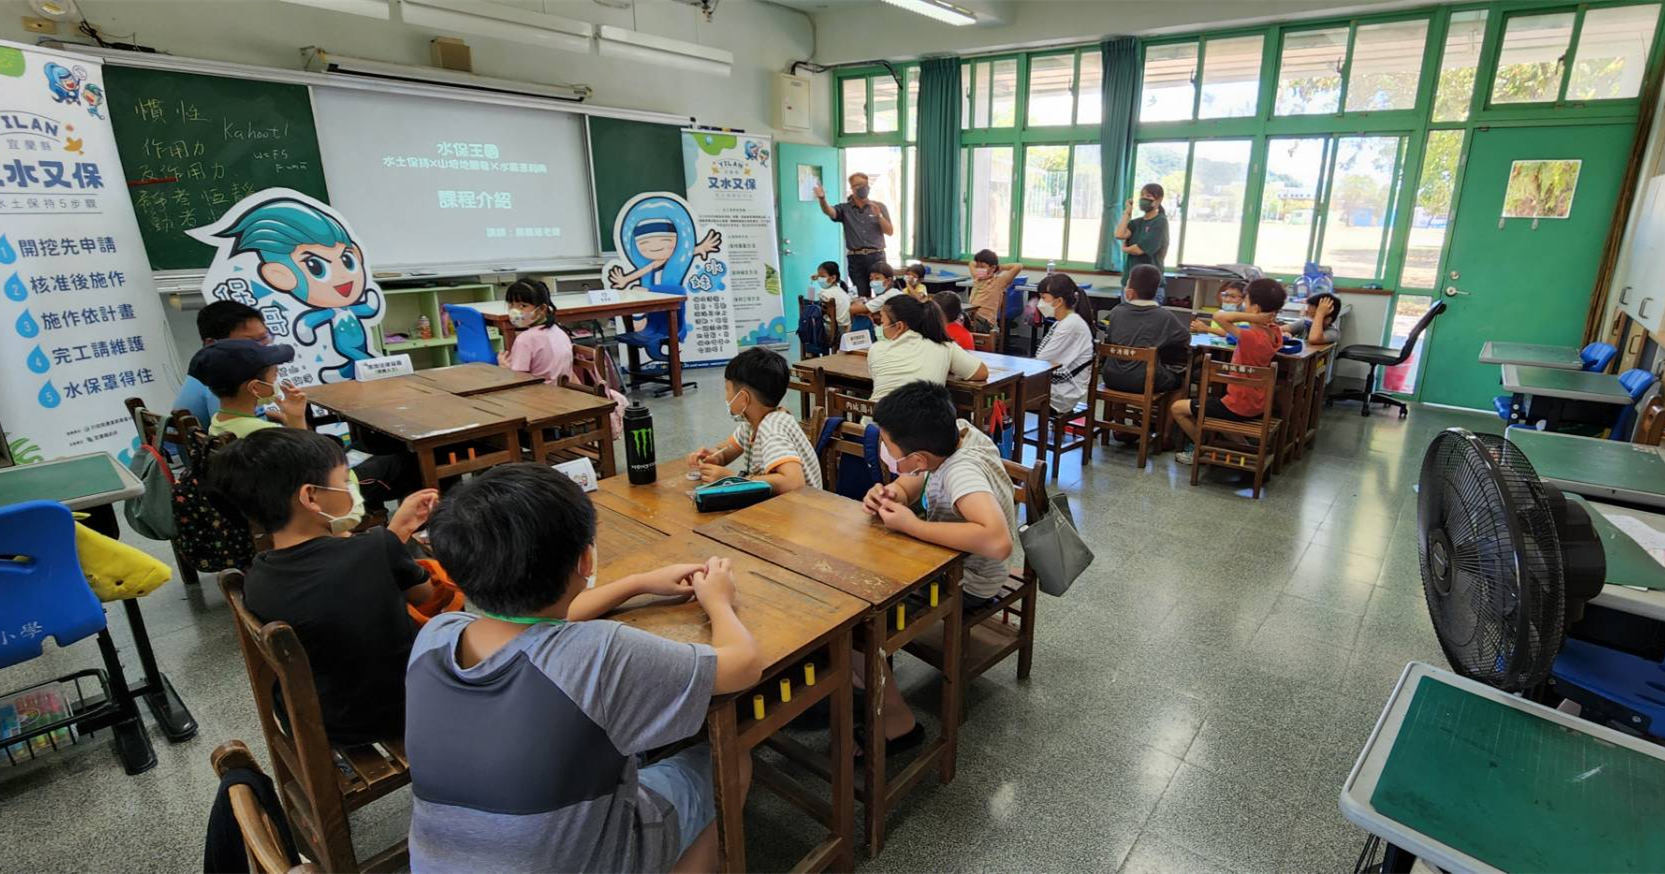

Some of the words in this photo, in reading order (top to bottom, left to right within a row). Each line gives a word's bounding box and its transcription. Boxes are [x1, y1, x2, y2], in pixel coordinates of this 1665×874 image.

[135, 98, 209, 124] 慣性
[0, 115, 58, 136] ILAN
[144, 138, 205, 159] 作用力
[0, 159, 104, 189] 水又保
[708, 177, 756, 190] 又水又保
[437, 189, 512, 209] 課程介紹
[18, 236, 117, 257] 開挖先申請
[30, 271, 126, 295] 核准後施作
[41, 304, 136, 330] 施作依計畫
[52, 336, 145, 365] 完工請維護
[63, 368, 154, 398] 水保罩得住
[1, 621, 42, 645] 小學
